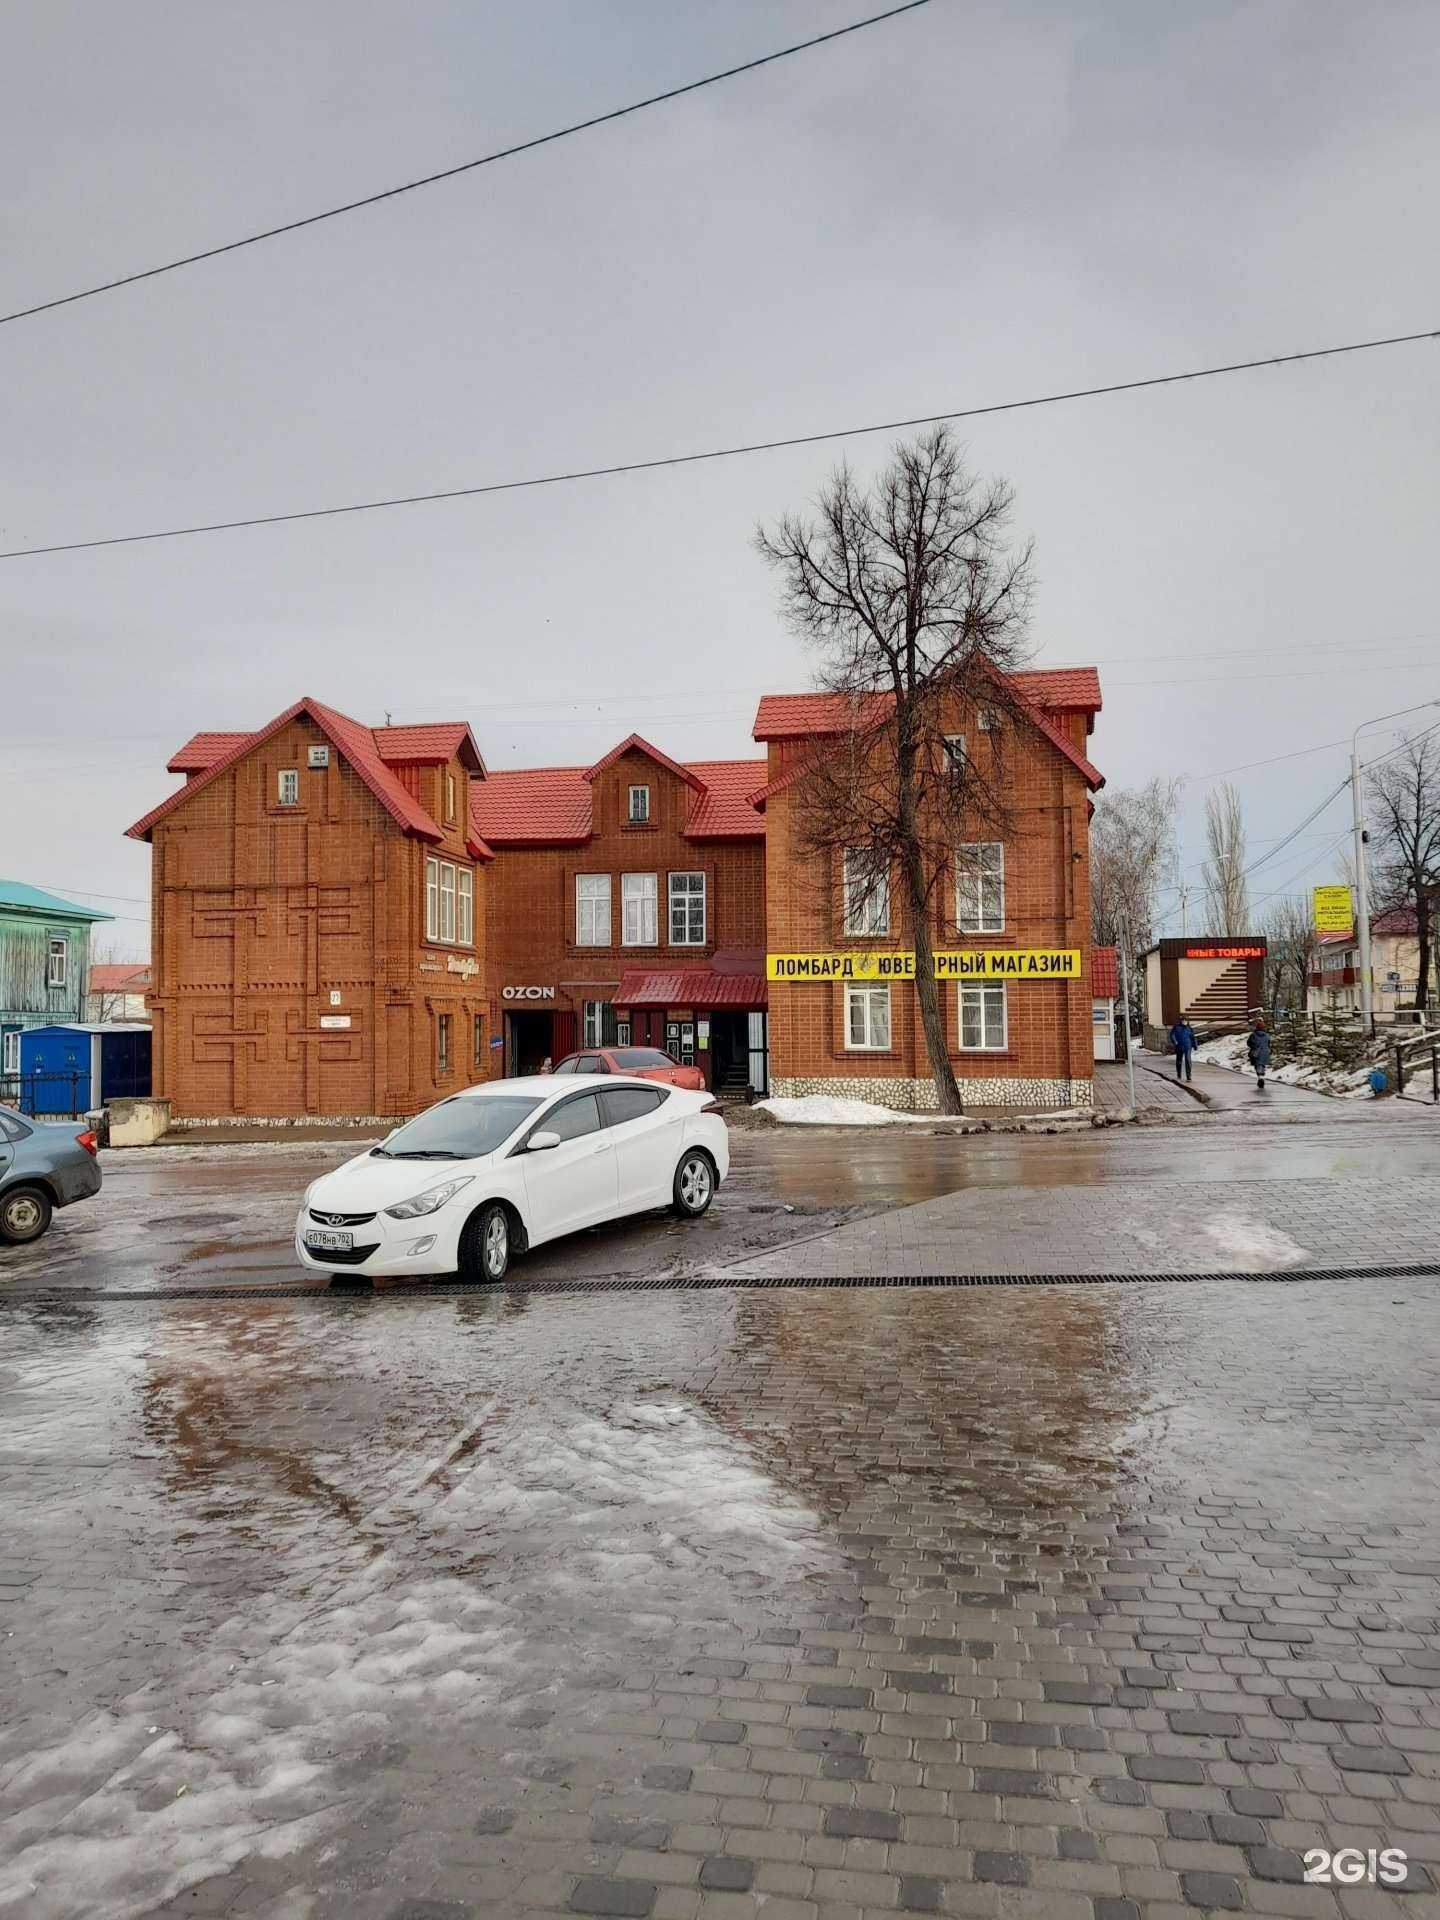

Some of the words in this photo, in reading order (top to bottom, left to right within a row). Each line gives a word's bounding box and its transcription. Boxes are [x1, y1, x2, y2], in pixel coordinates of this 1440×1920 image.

[1218, 947, 1261, 957] ТОВАРЫ
[776, 959, 853, 977] ЛОМБАРД
[879, 952, 986, 974] ЮВЕРНЫЙ
[992, 955, 1073, 973] МАГАЗИН
[503, 986, 555, 999] OZON
